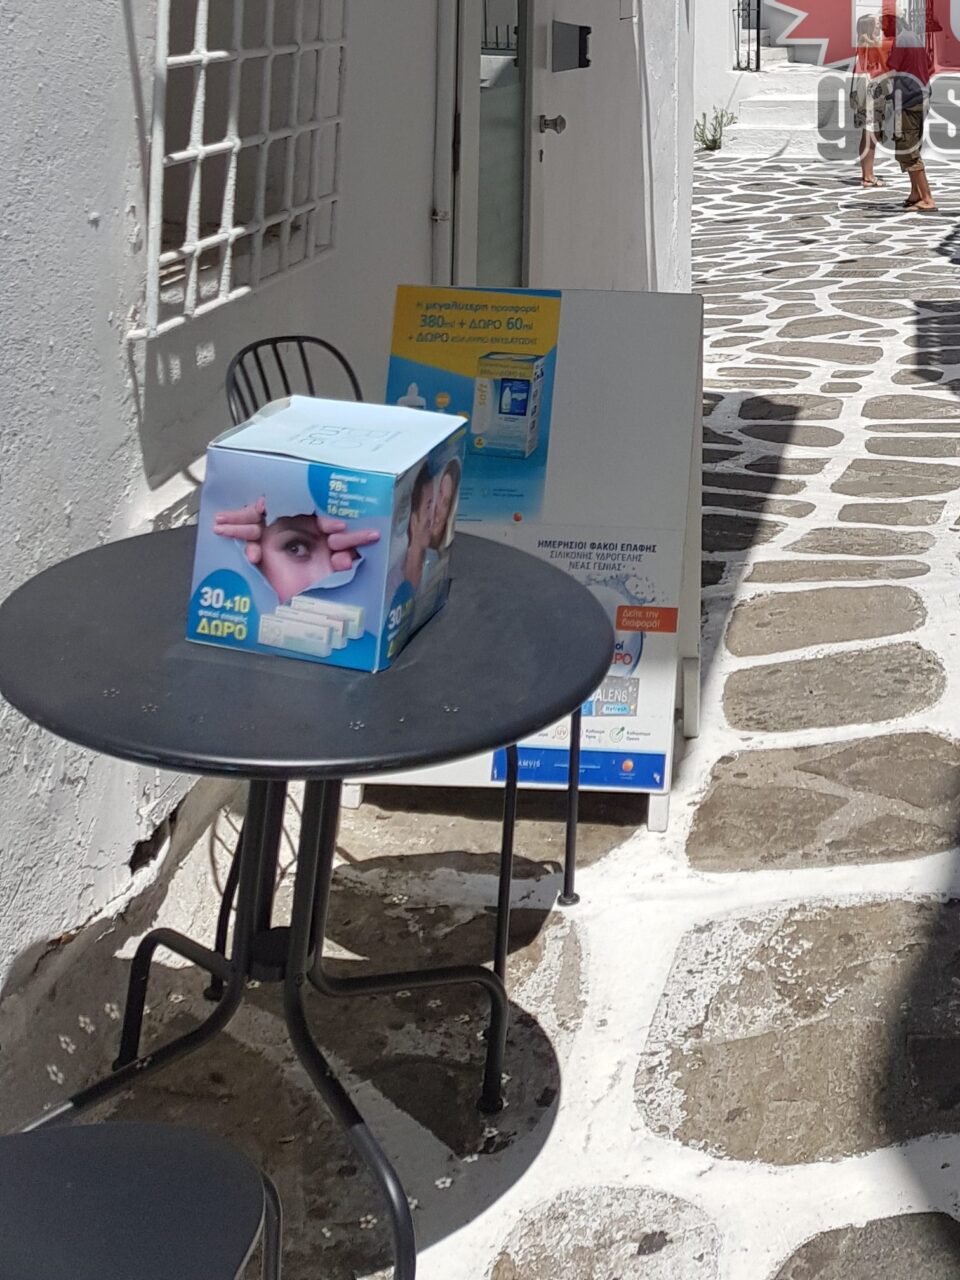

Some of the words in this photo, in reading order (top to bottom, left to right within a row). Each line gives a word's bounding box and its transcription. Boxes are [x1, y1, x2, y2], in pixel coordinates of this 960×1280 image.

[468, 319, 502, 330] ΔΩΡΟ
[537, 540, 587, 550] ΗΜΕΡΗΣΙΟΙ
[590, 542, 618, 551] ΦΑΚΟΙ
[620, 543, 657, 553] ΕΠΑΦΗΣ
[569, 561, 590, 570] ΝΕΑΣ
[196, 617, 248, 641] ΔΩΡΟ
